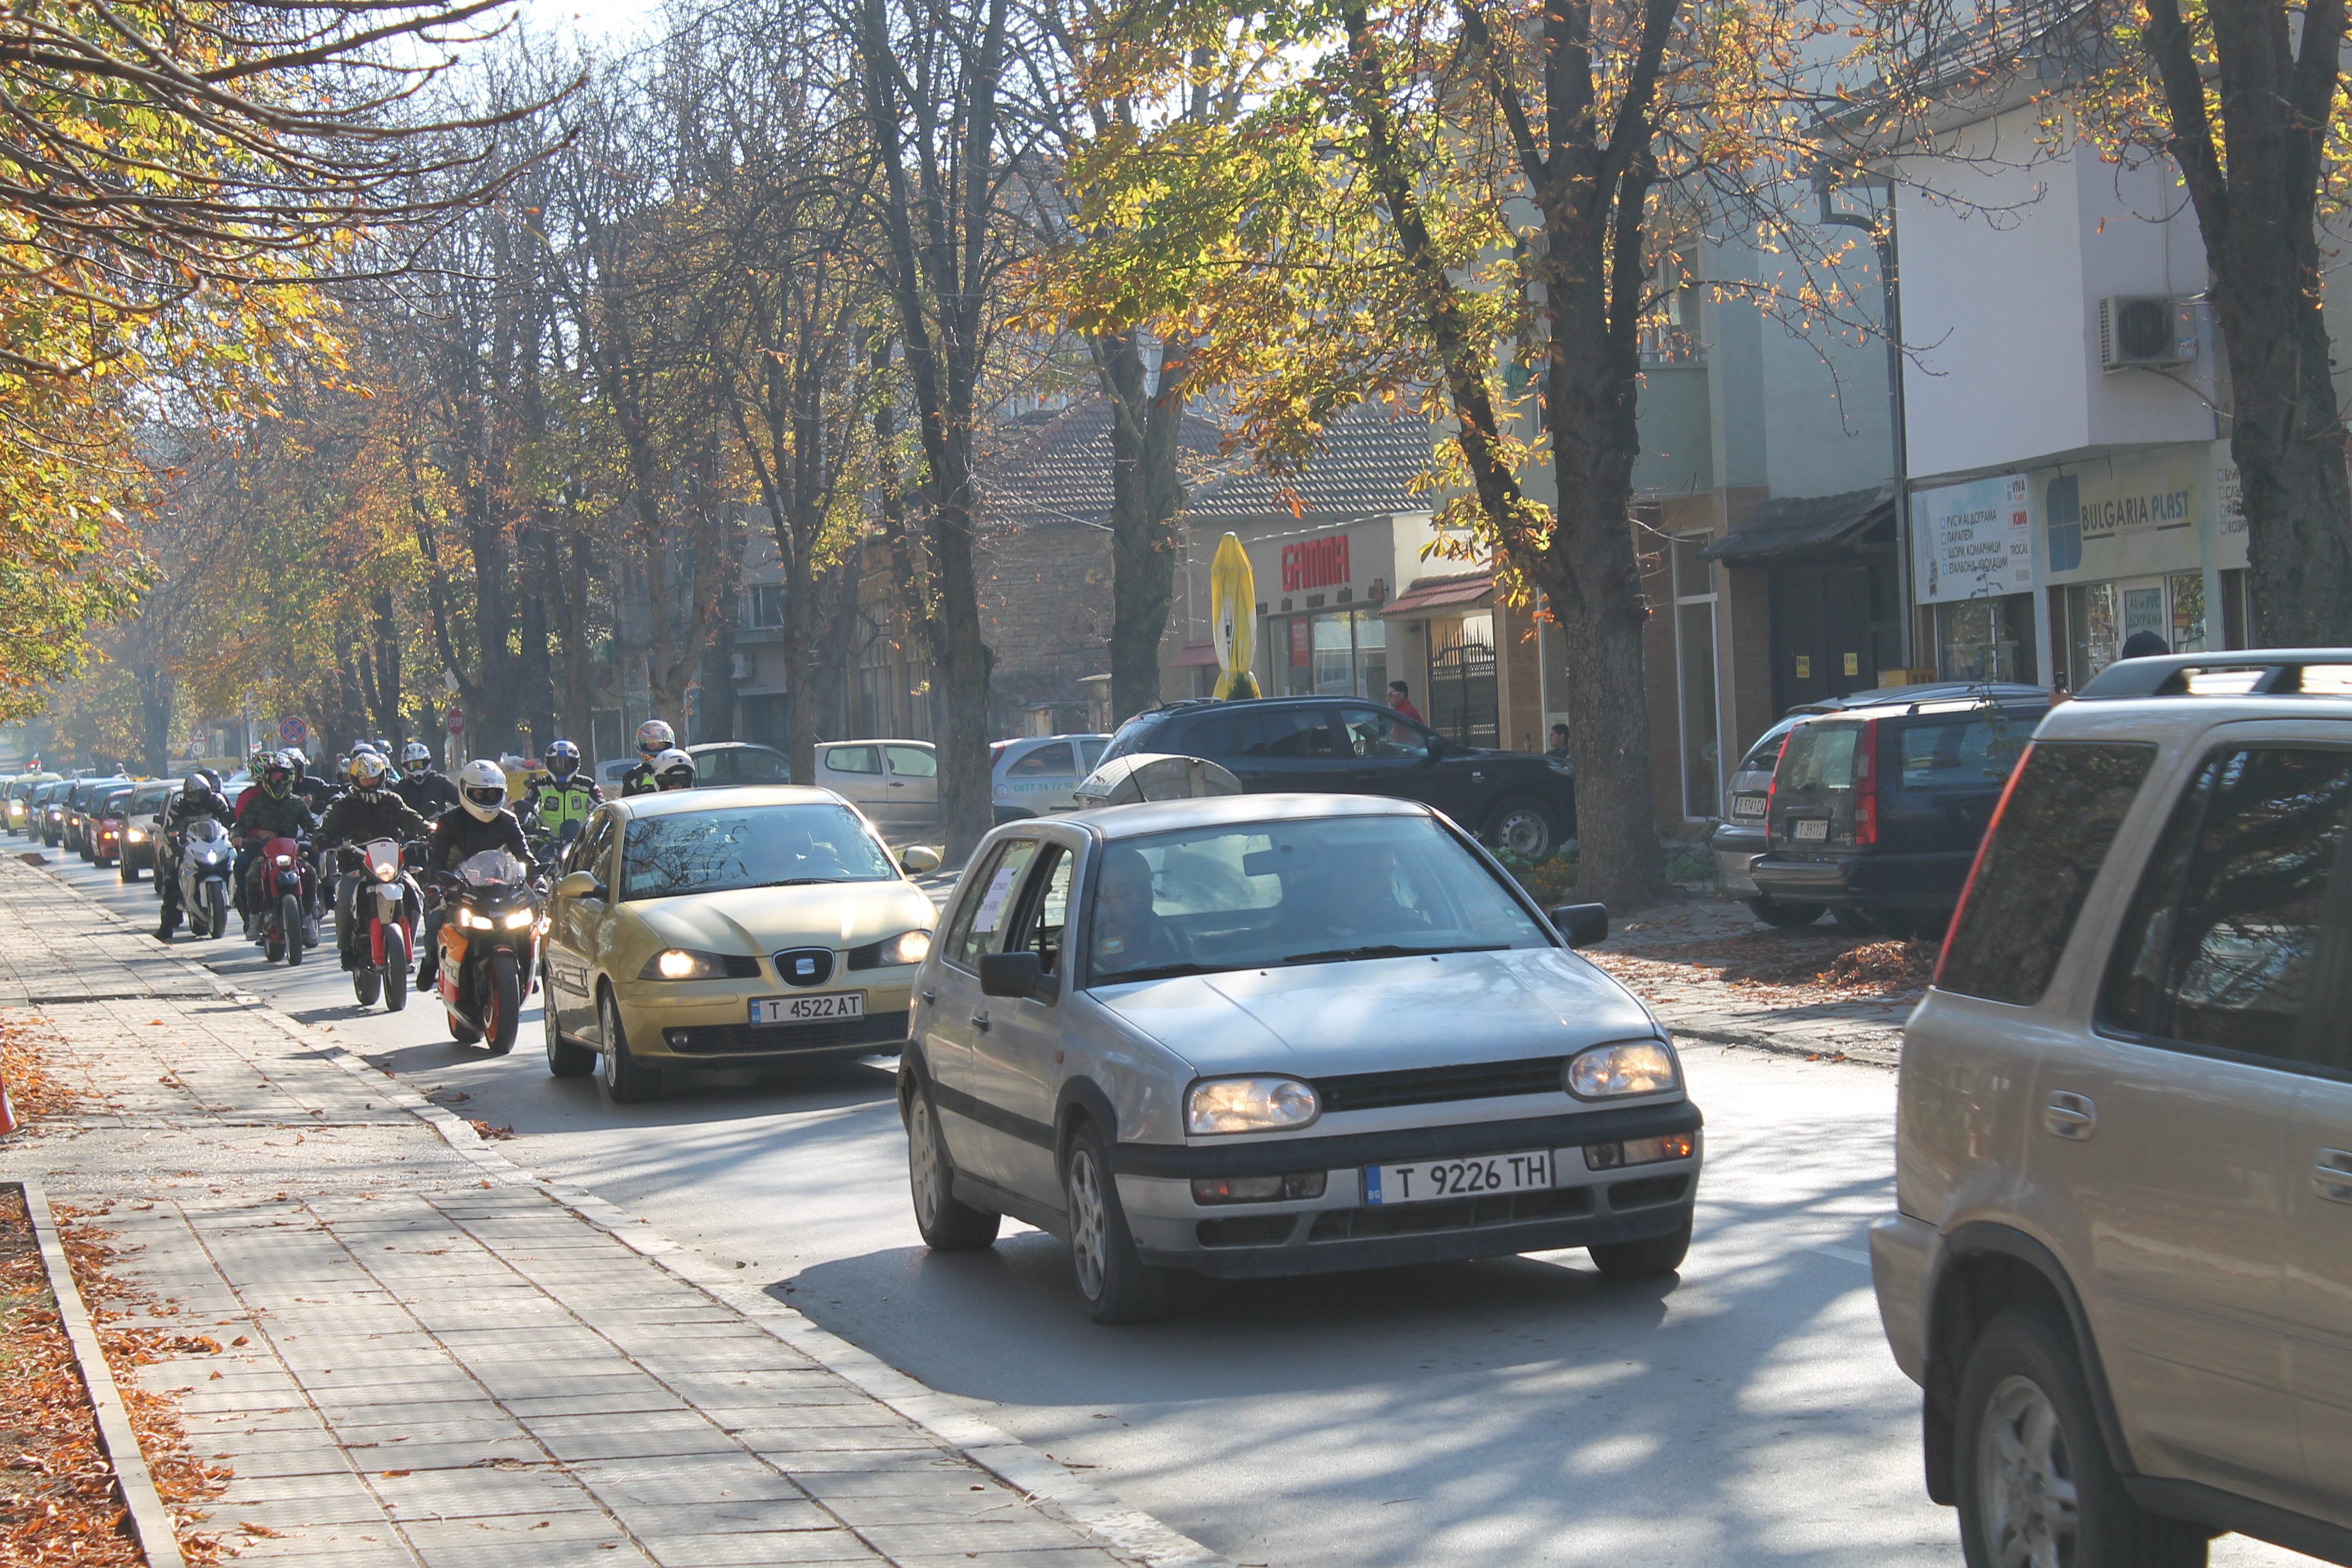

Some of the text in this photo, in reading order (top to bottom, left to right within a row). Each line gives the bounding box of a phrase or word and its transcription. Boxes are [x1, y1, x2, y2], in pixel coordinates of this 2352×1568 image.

[2012, 479, 2026, 493] VIVA
[1970, 509, 1997, 526] ДОГРАМА
[2081, 490, 2189, 531] BULGARIA PLAST
[2228, 519, 2248, 534] КОЗИР
[1947, 529, 1974, 543] ПАРАПЕТИ
[1967, 541, 2001, 557] КОМАРНИЦИ
[2010, 543, 2029, 555] TROCAL
[1282, 534, 1350, 592] GAMMA
[2130, 597, 2138, 609] AL
[2146, 596, 2161, 607] PVC
[2128, 613, 2163, 629] ДОГРАМА
[449, 717, 463, 727] STOP
[193, 744, 203, 753] 40
[1014, 783, 1035, 792] 0877
[1038, 783, 1048, 791] 34
[1051, 782, 1061, 791] 72
[1396, 1168, 1414, 1198] T
[1368, 1190, 1381, 1200] BG
